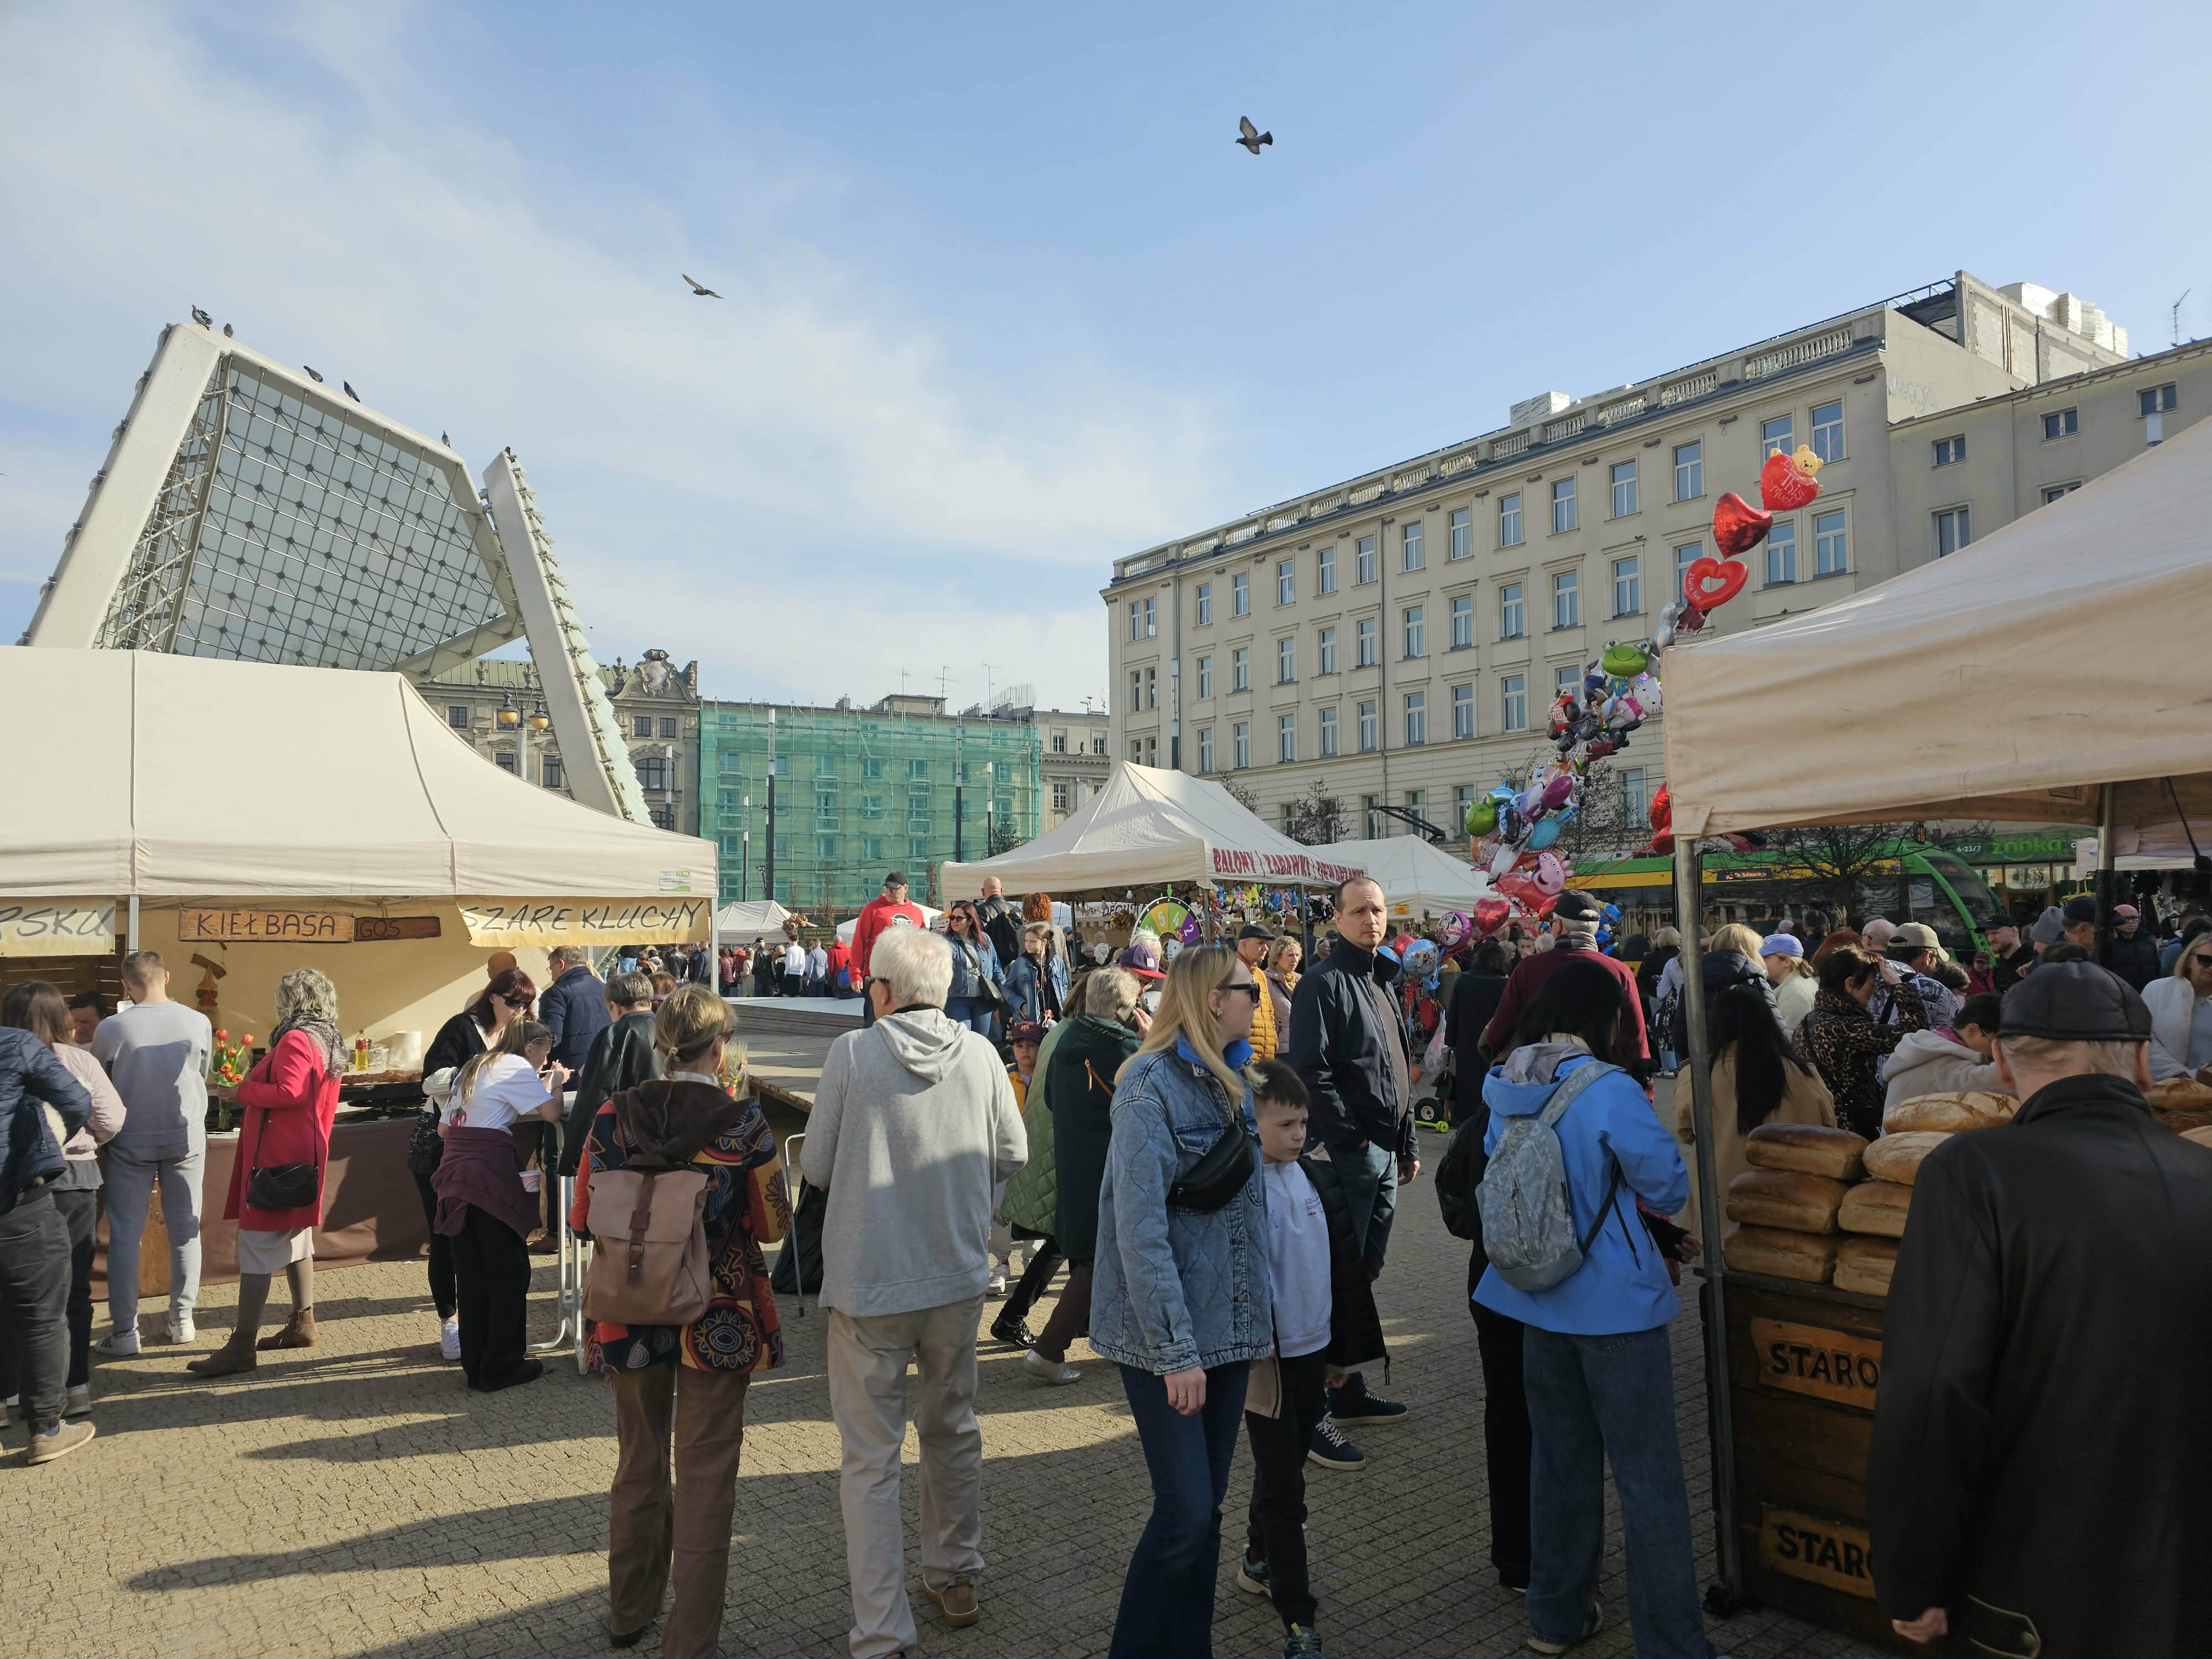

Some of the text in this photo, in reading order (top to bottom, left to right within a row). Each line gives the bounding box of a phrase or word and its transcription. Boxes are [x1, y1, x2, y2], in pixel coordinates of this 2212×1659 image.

[1781, 468, 1805, 500] This
[1212, 848, 1256, 874] BALONY
[1262, 854, 1311, 877] ZABAWKI
[197, 912, 336, 937] KIEŁBASA
[462, 901, 704, 933] SZARE KLUCHY
[1157, 911, 1166, 927] 5
[1173, 911, 1180, 927] 4
[1776, 1525, 1872, 1580] STAR
